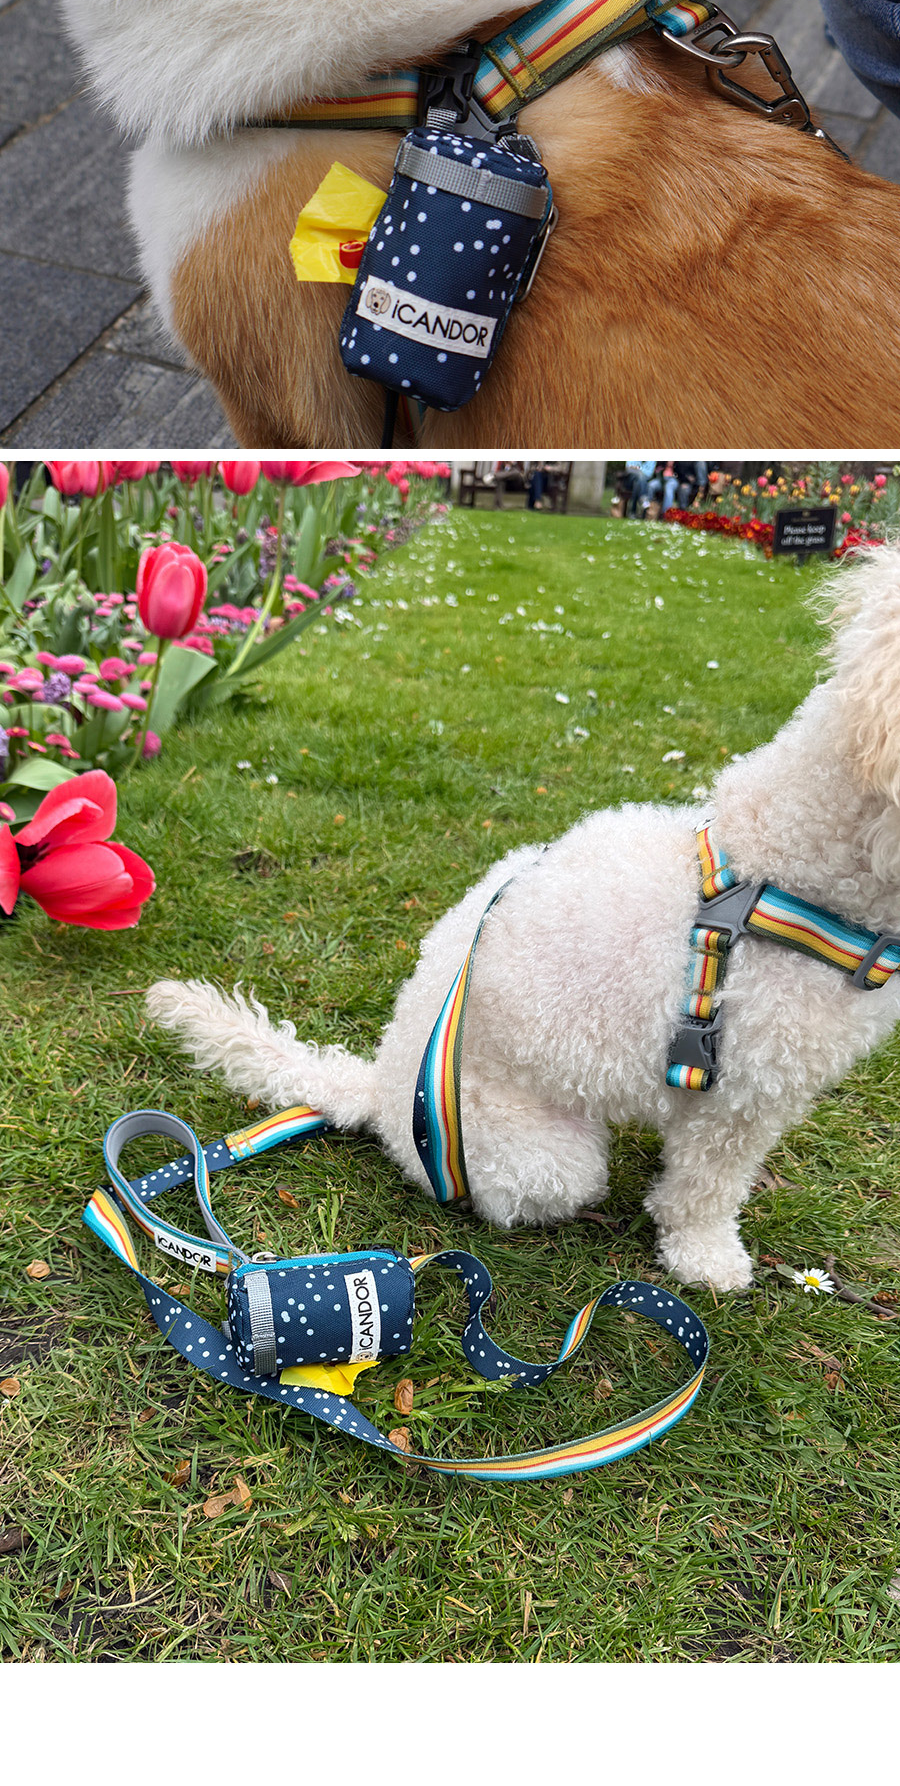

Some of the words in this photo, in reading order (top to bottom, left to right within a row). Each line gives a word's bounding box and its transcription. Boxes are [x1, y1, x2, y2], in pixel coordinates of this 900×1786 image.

[391, 299, 489, 347] iCANDOR
[783, 524, 807, 536] Please
[806, 523, 827, 536] keep
[780, 536, 793, 546] off
[792, 536, 806, 546] the
